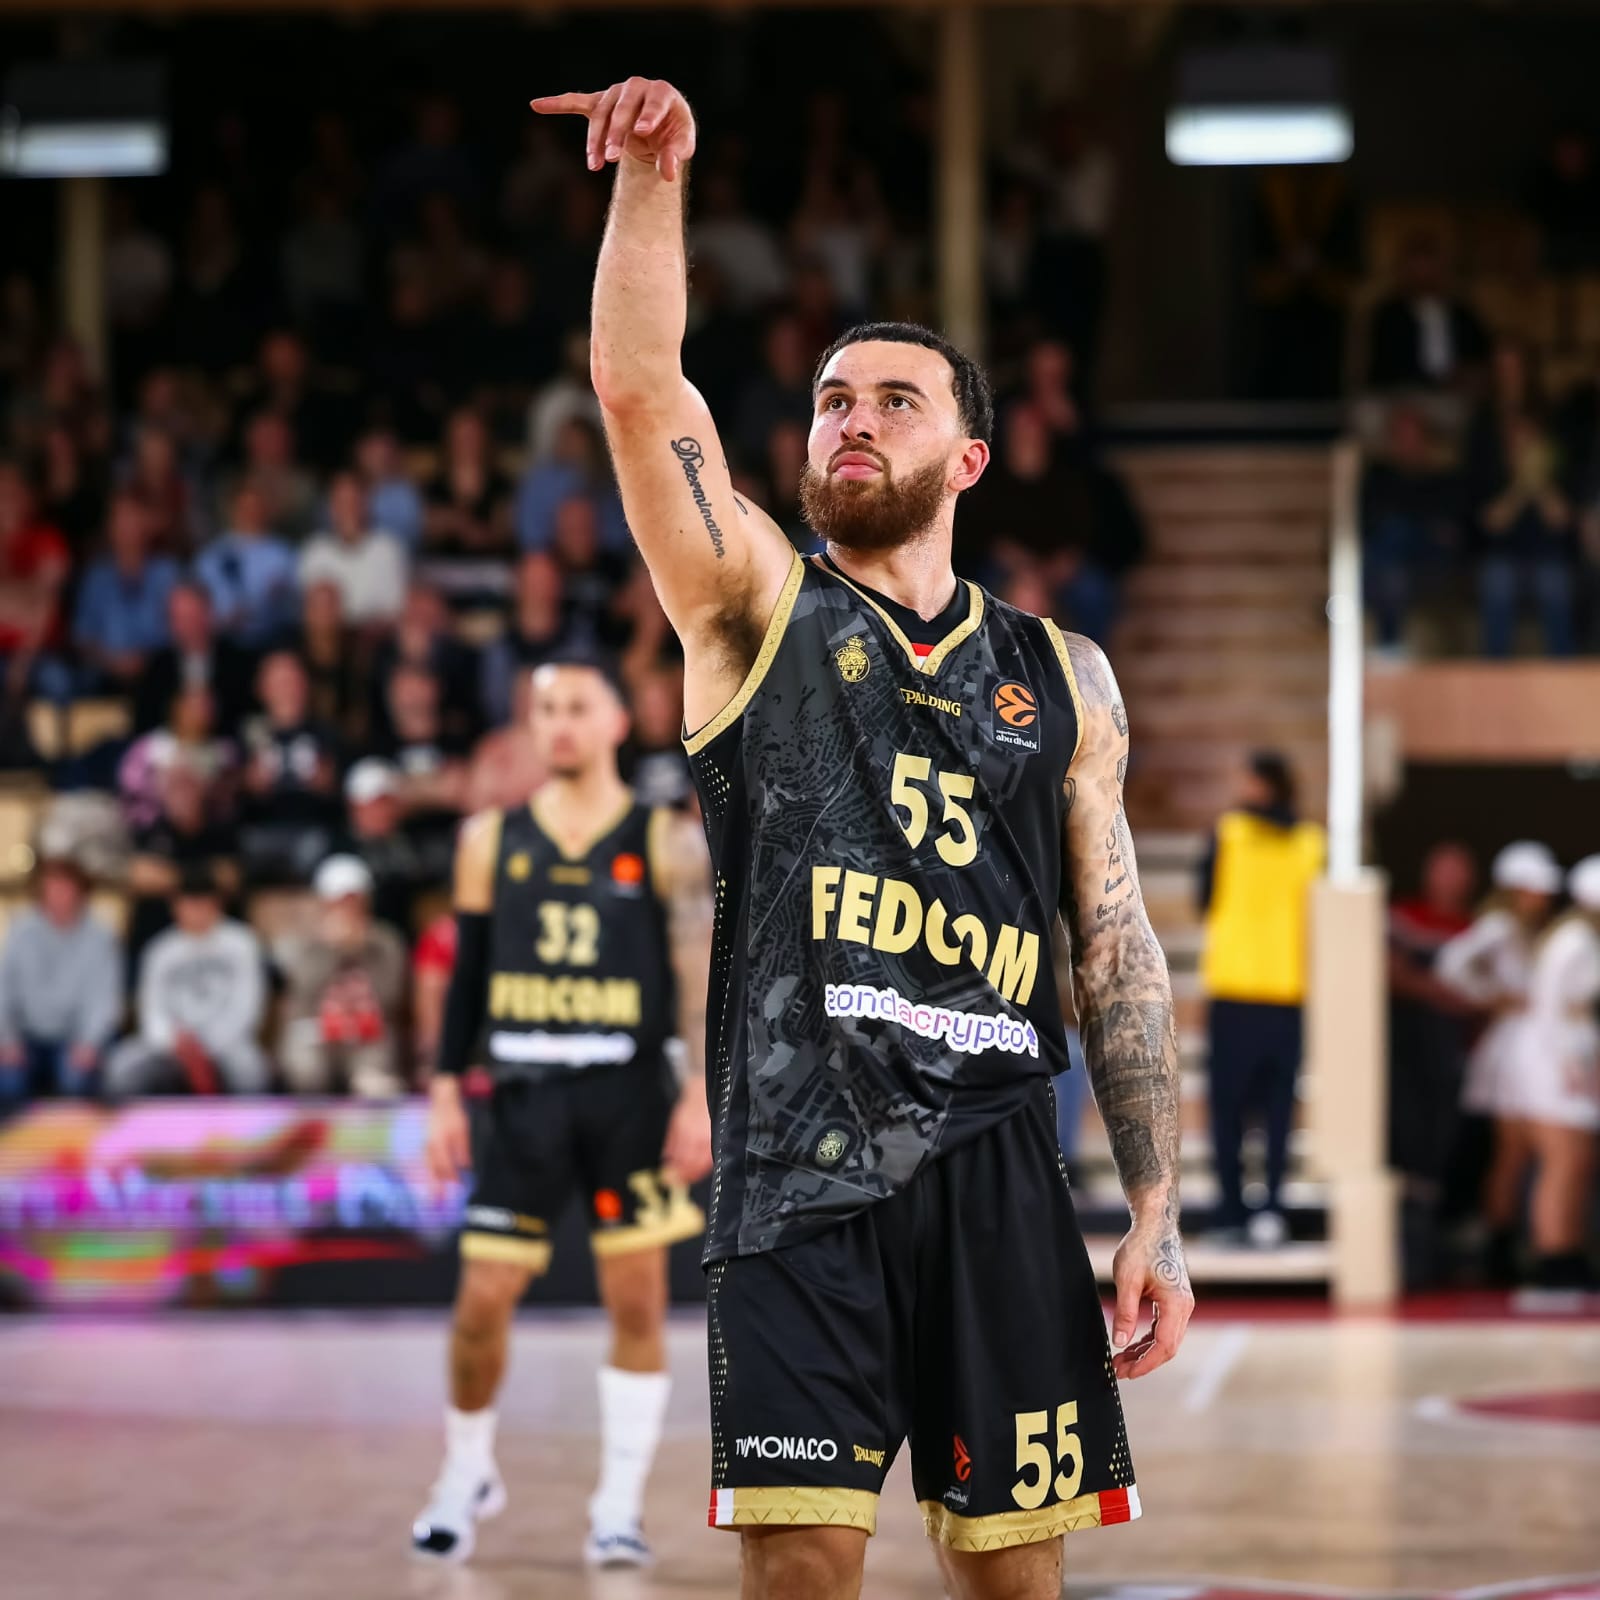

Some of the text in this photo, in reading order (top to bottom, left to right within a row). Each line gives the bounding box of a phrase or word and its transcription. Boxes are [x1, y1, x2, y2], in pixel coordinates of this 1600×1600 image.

[671, 437, 725, 559] Determination
[891, 752, 978, 867] 55
[1011, 1400, 1083, 1510] 55
